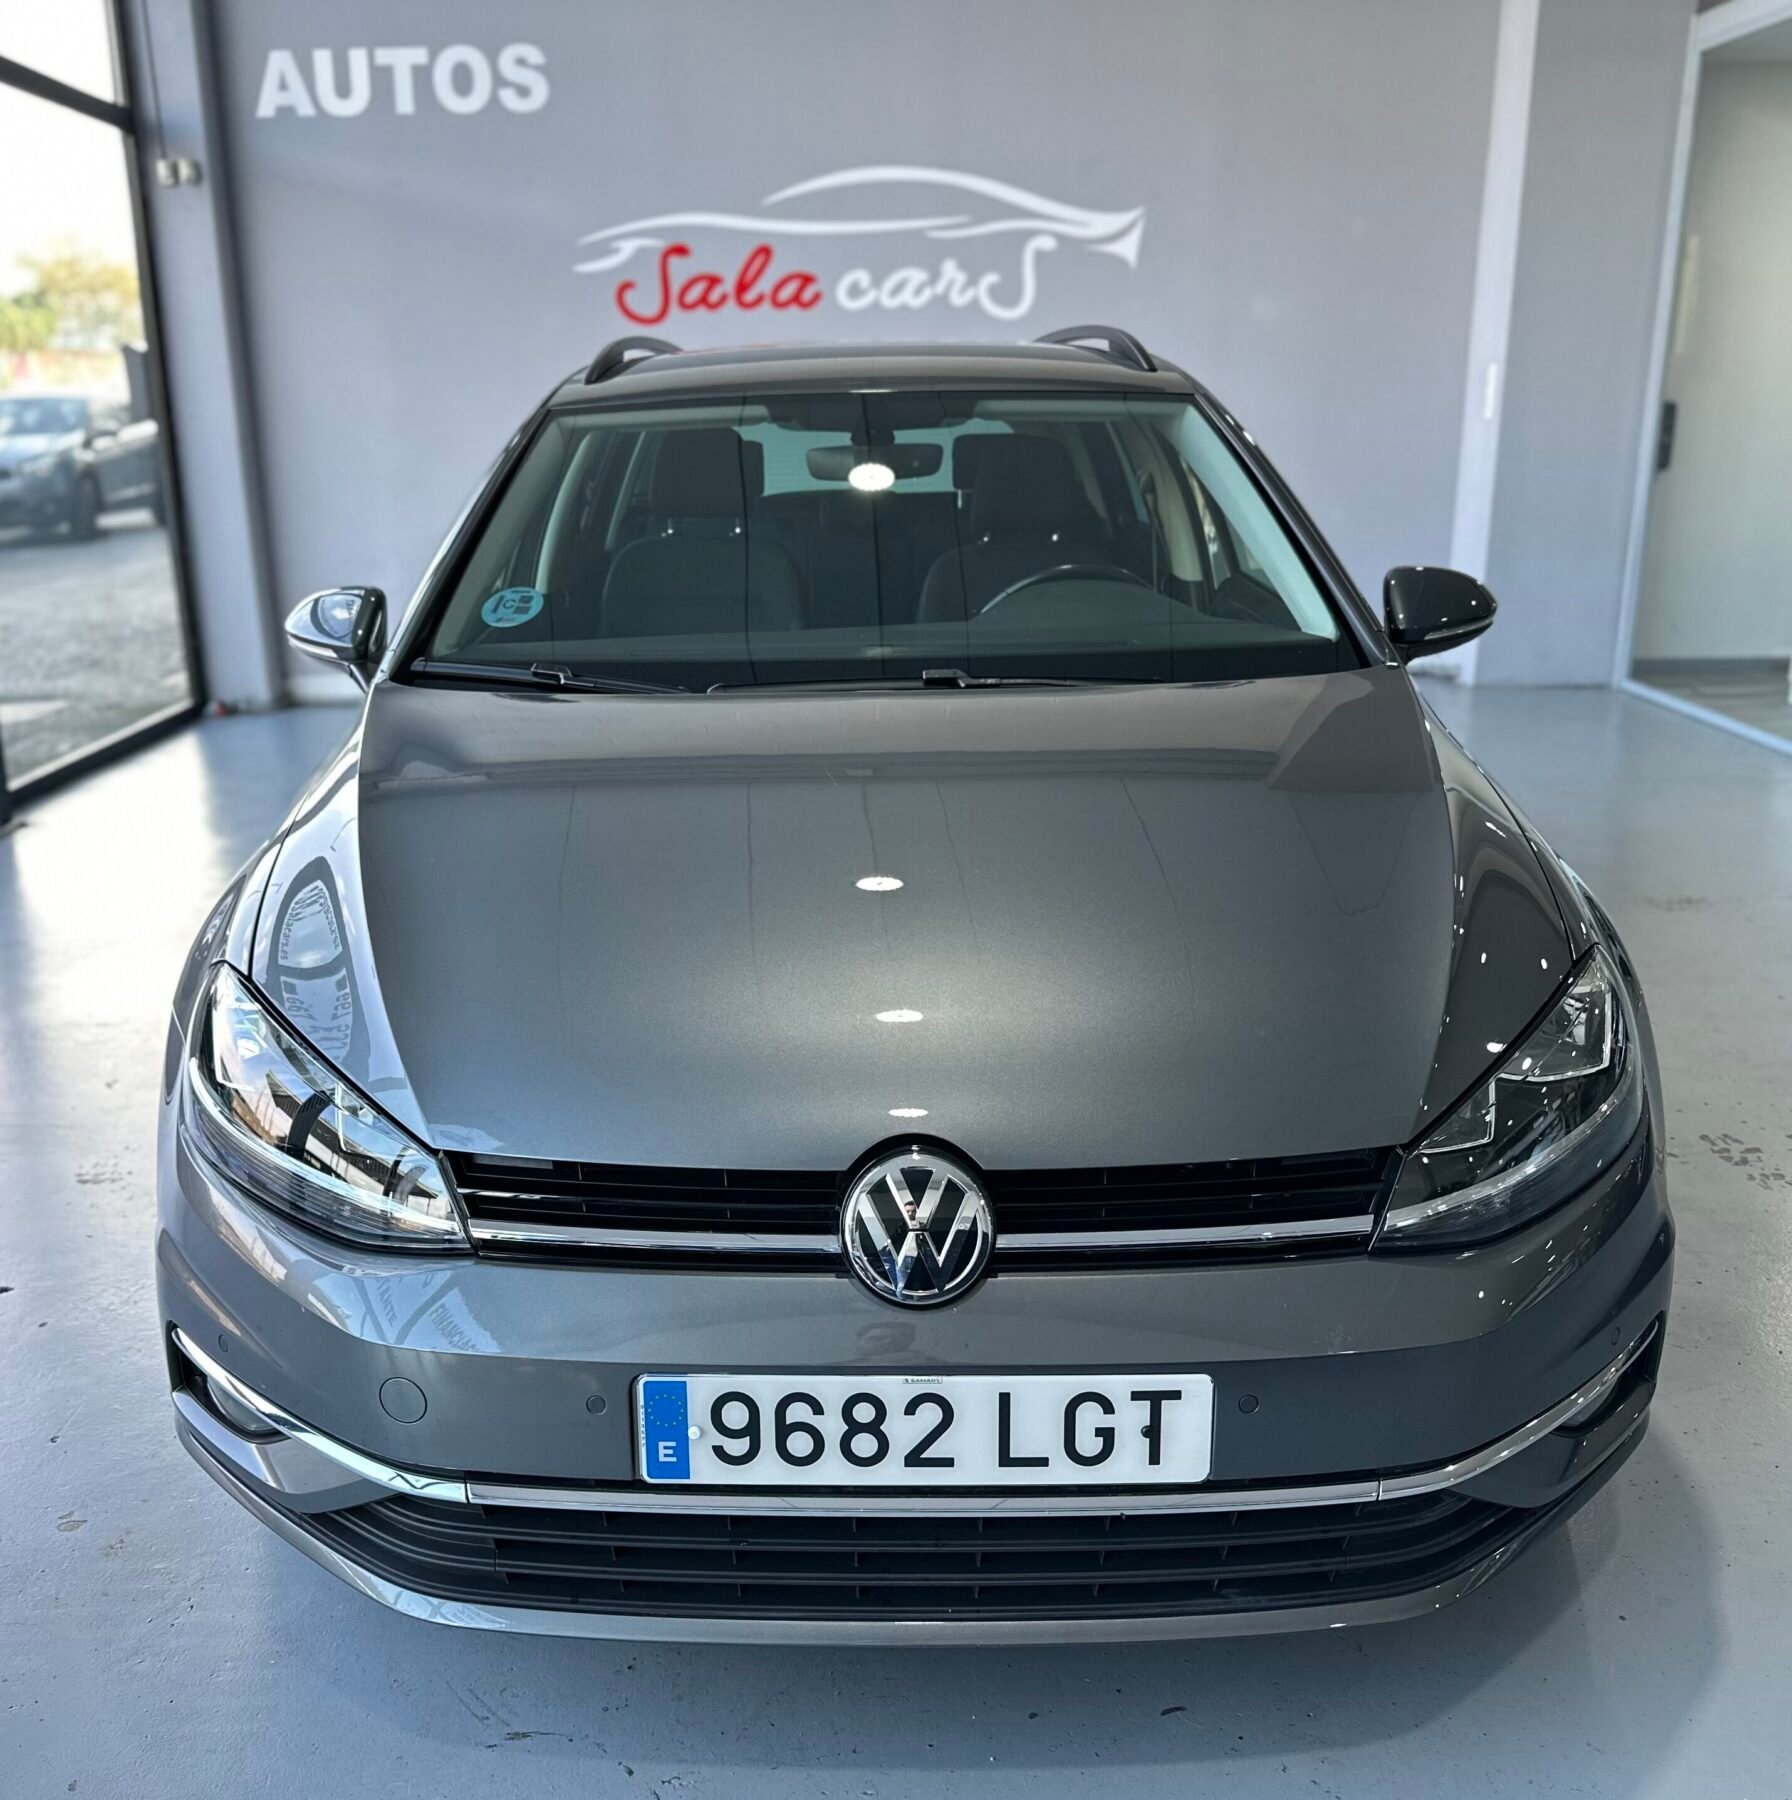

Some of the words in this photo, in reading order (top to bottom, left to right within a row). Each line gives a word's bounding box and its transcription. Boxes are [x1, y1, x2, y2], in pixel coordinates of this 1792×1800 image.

[256, 43, 551, 118] AUTOS
[614, 243, 822, 326] Sala
[658, 1441, 678, 1462] E
[710, 1391, 955, 1468] 9682
[998, 1389, 1183, 1468] LGT
